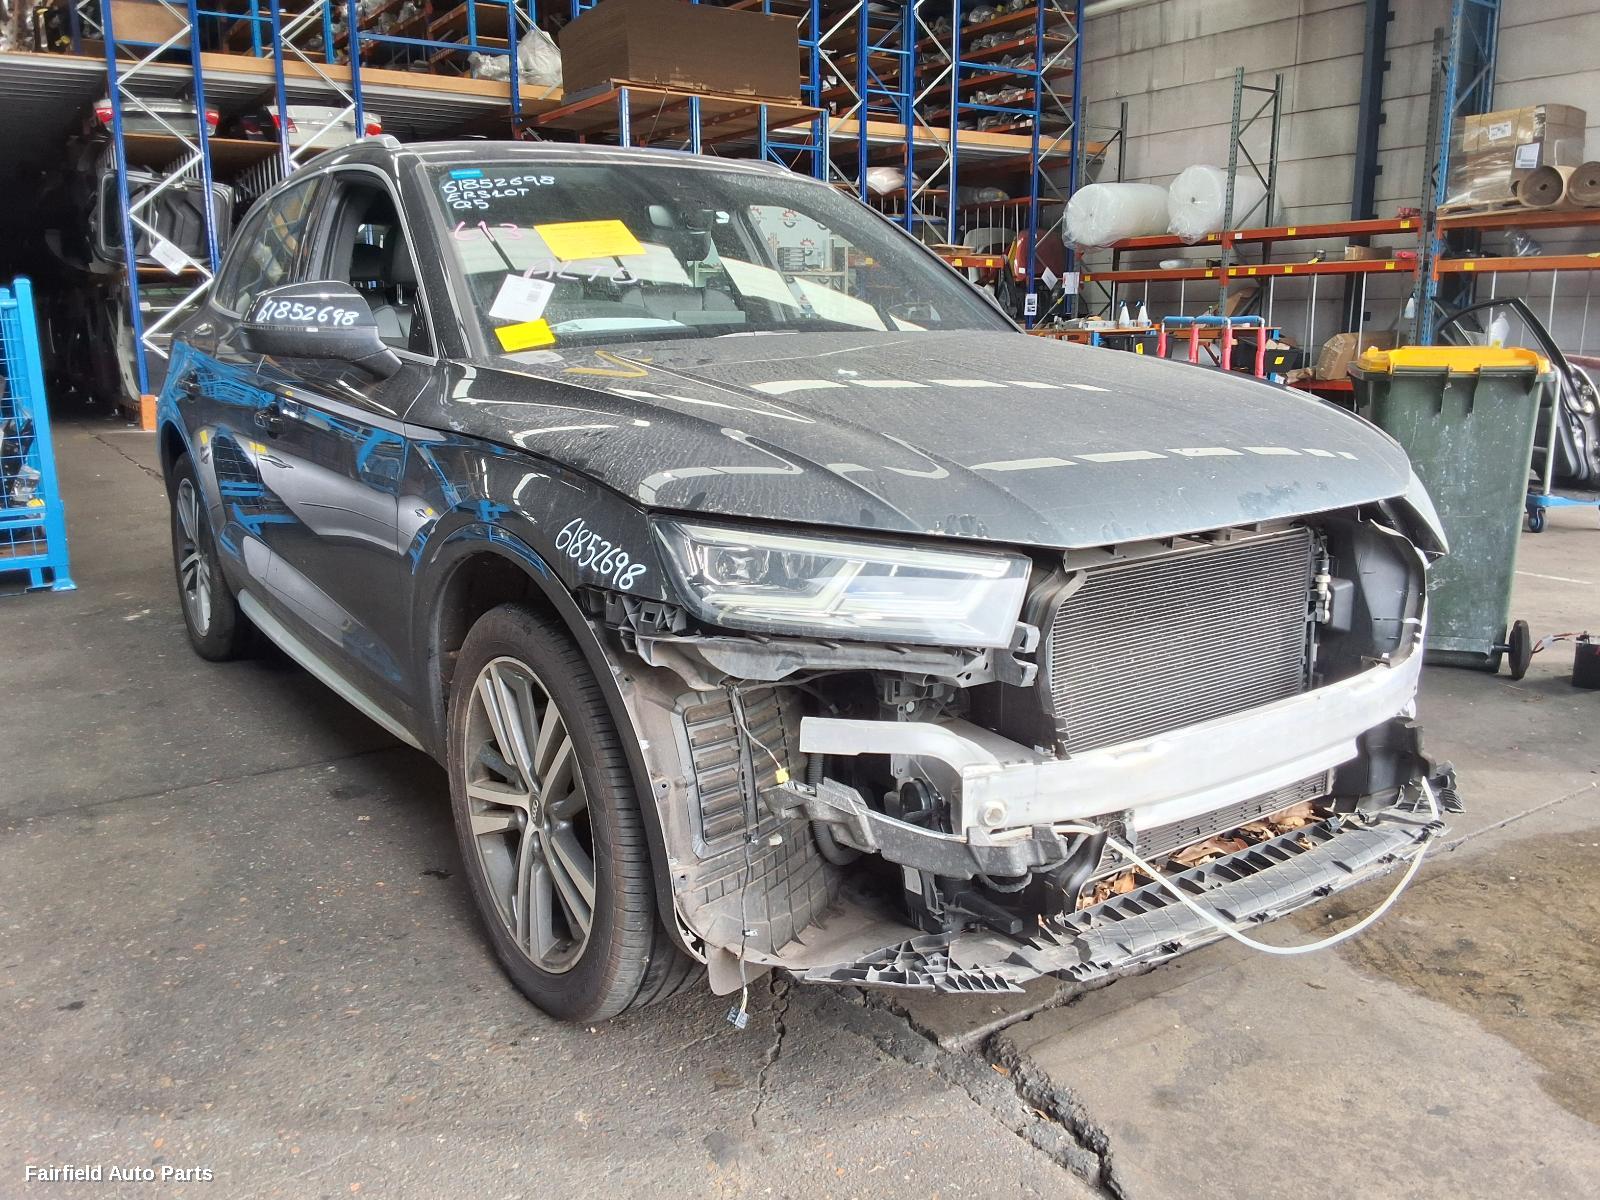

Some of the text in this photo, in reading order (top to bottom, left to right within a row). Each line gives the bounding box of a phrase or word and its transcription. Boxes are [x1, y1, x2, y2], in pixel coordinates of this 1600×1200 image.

[442, 175, 556, 194] 61852698
[453, 199, 490, 210] Q5
[256, 297, 359, 326] 61852698
[555, 517, 647, 590] 61852698
